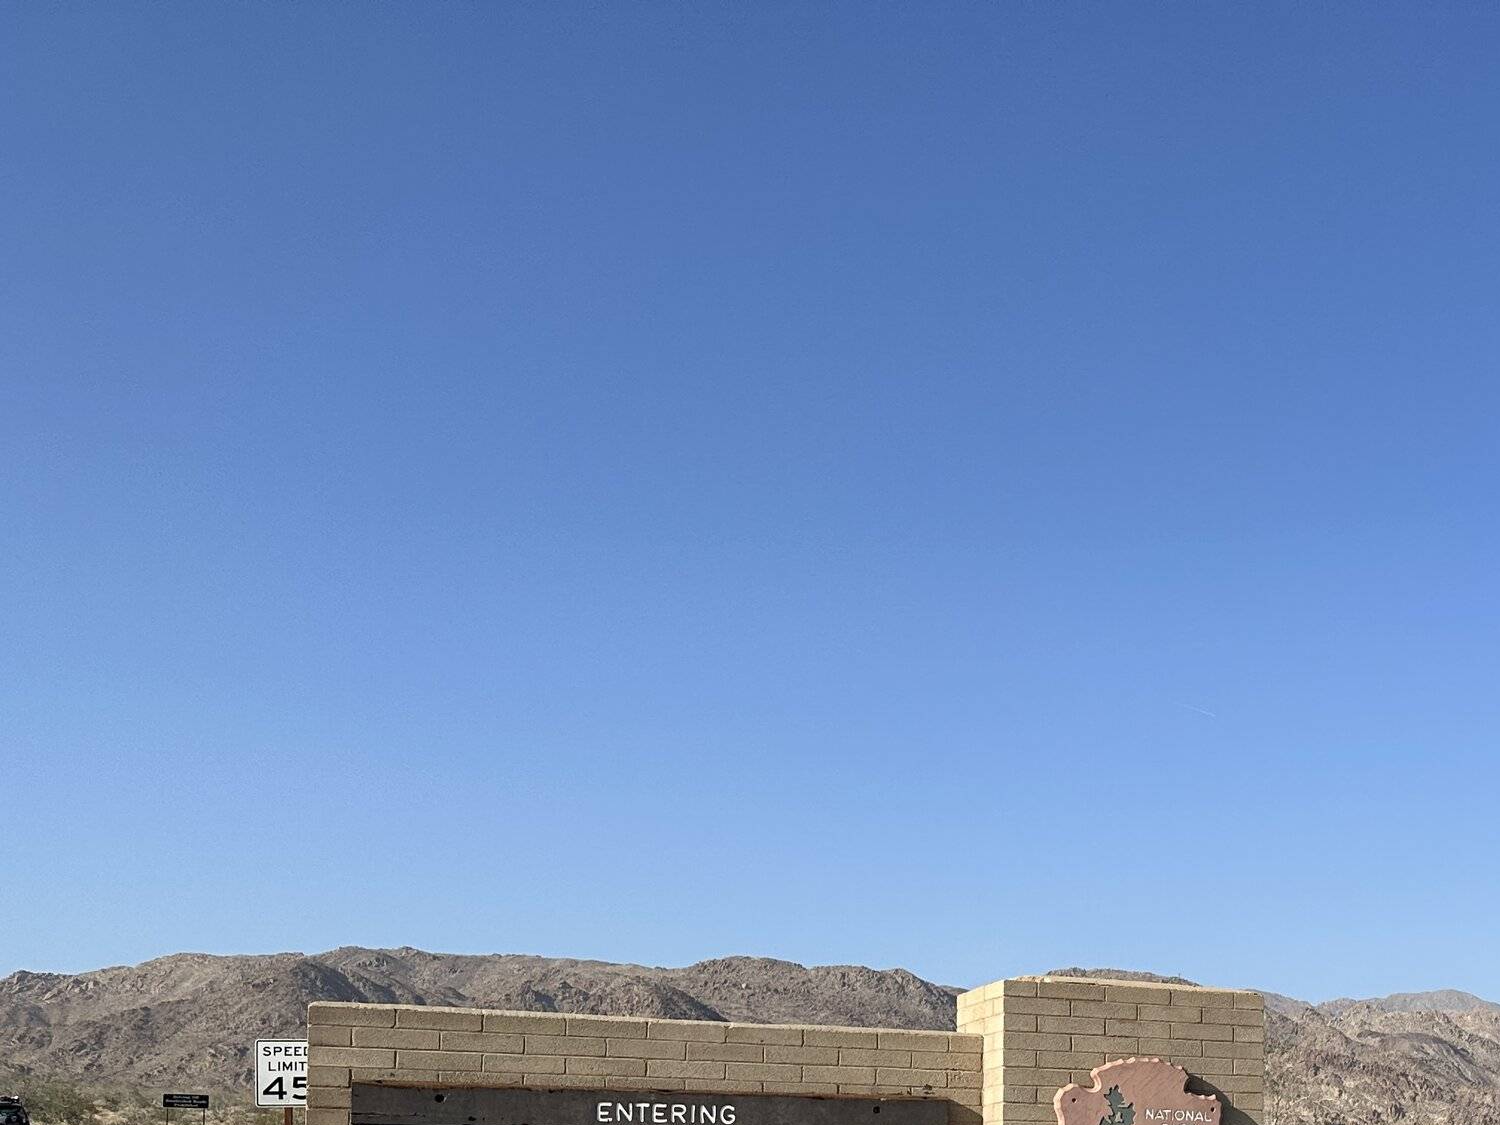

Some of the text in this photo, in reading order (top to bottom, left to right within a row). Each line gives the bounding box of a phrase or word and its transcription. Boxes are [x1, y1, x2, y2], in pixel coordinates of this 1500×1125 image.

[263, 1046, 307, 1057] SPEE
[268, 1061, 307, 1072] LIMIT
[263, 1076, 307, 1100] 45
[597, 1102, 736, 1125] ENTERING
[1145, 1108, 1212, 1122] NATIONAL
